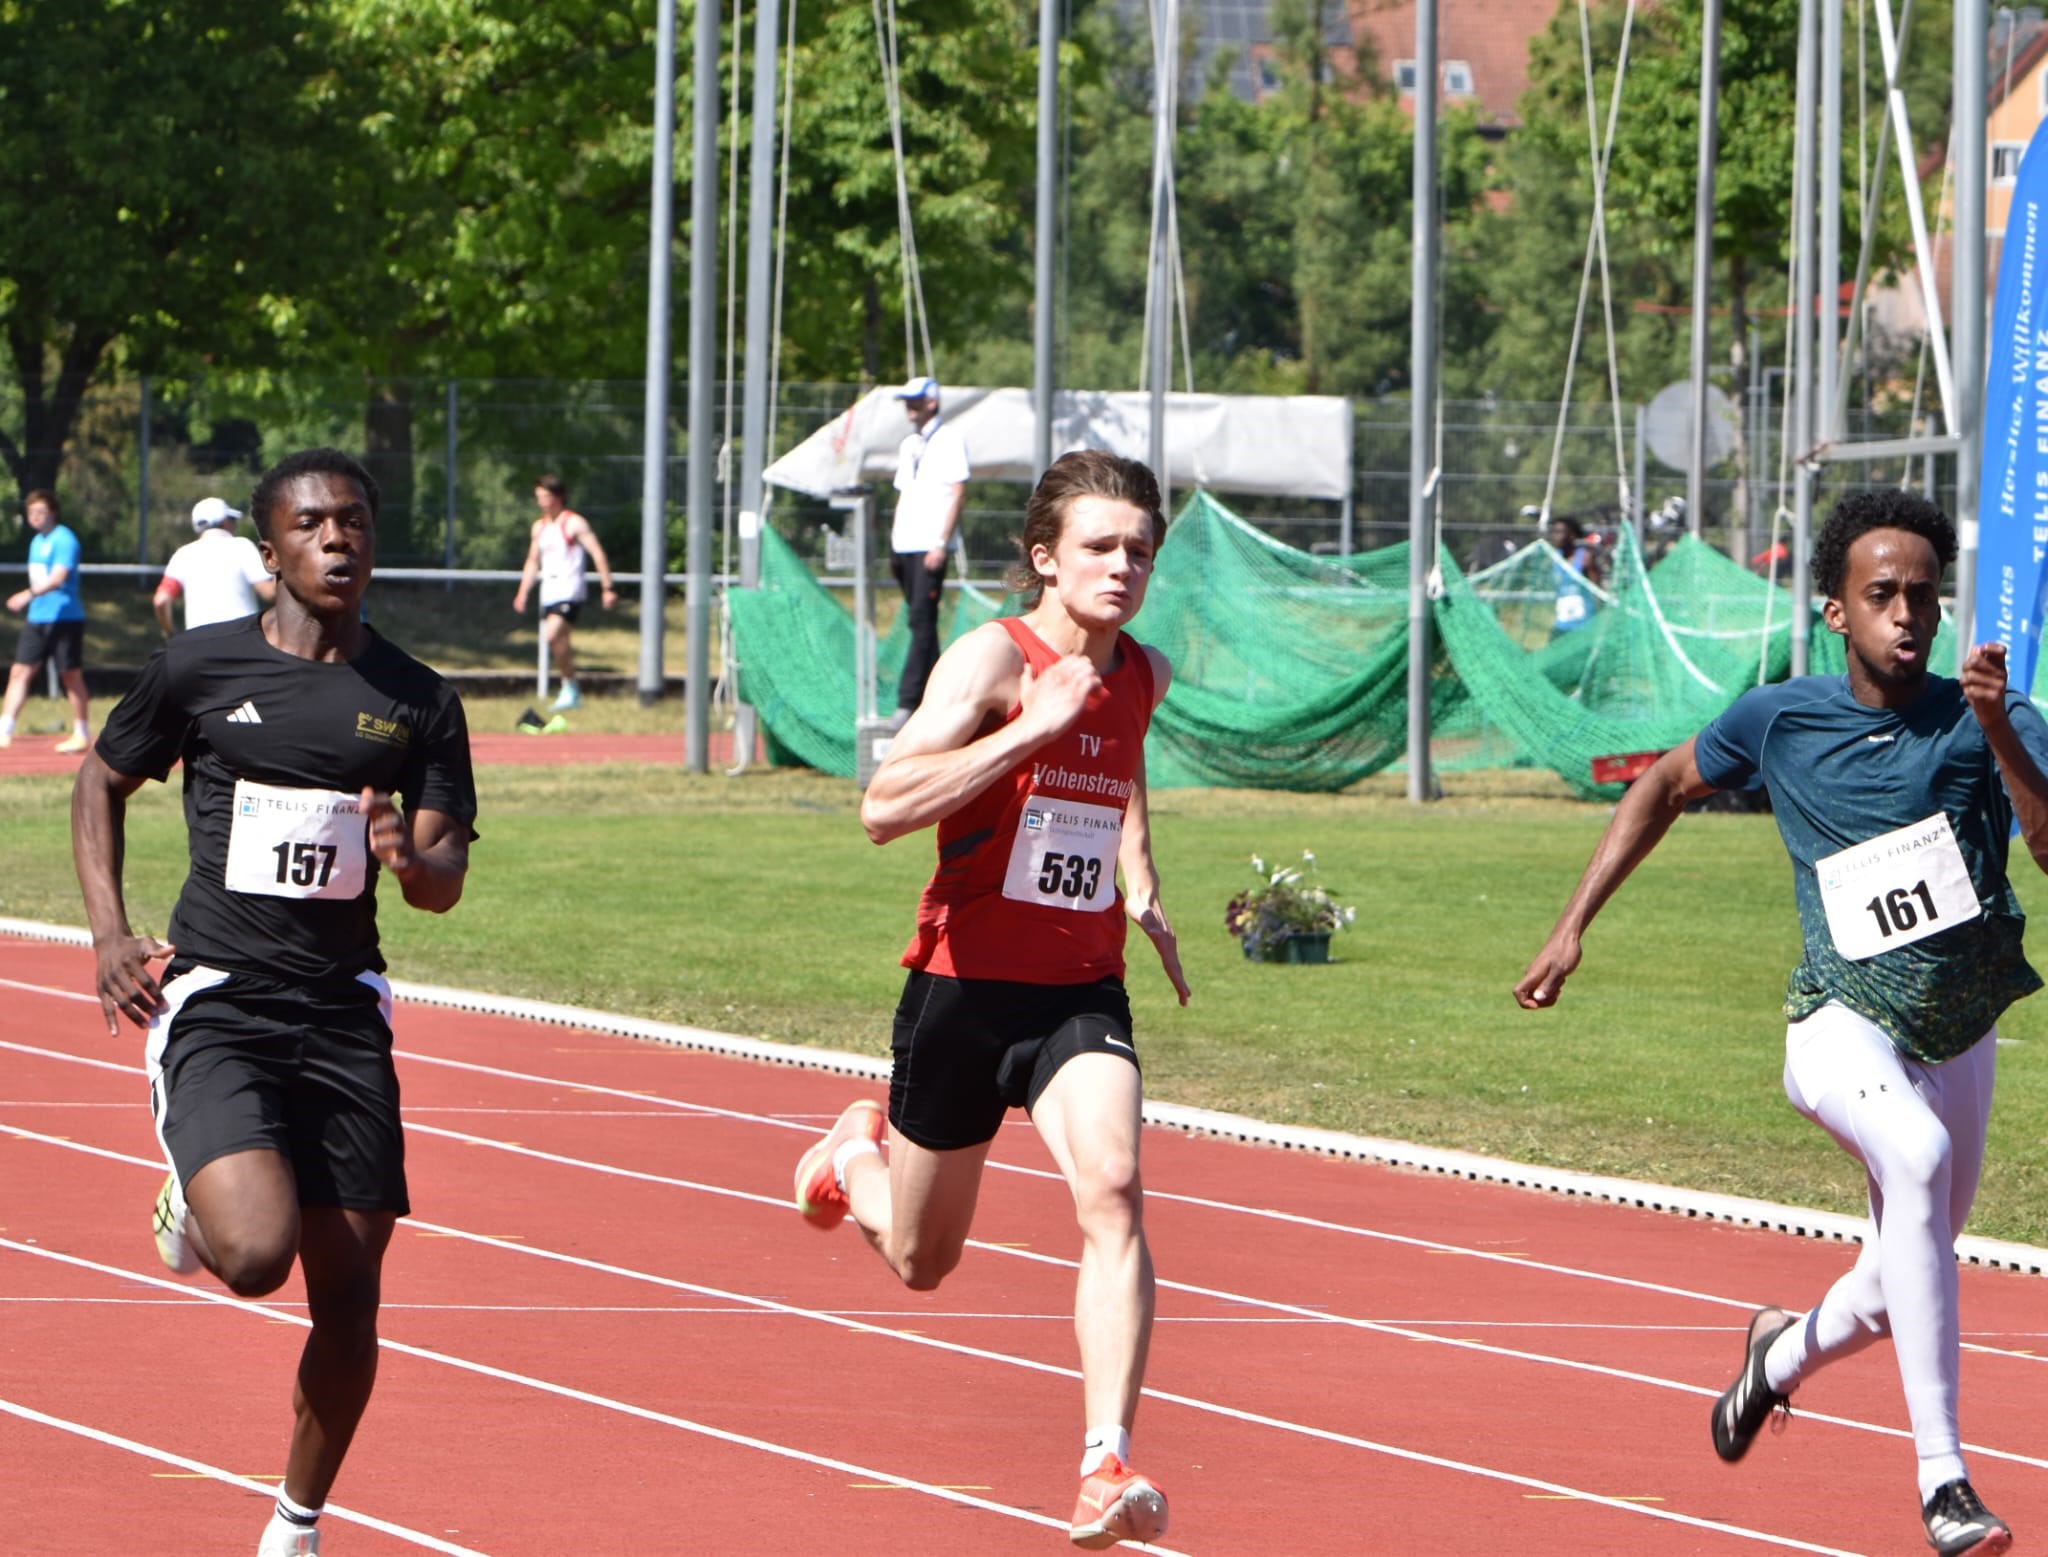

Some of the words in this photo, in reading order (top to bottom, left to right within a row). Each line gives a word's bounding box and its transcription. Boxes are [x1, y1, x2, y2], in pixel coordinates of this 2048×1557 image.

[2001, 395, 2023, 517] Herzlich
[2012, 202, 2038, 383] Willkommen
[2033, 471, 2048, 563] TELIS
[1080, 733, 1101, 757] TV
[266, 798, 308, 812] TELIS
[1051, 812, 1080, 826] TELIS
[272, 841, 337, 886] 157
[1887, 830, 1941, 858] FINANZ
[1038, 851, 1101, 900] 533
[1866, 879, 1939, 938] 161
